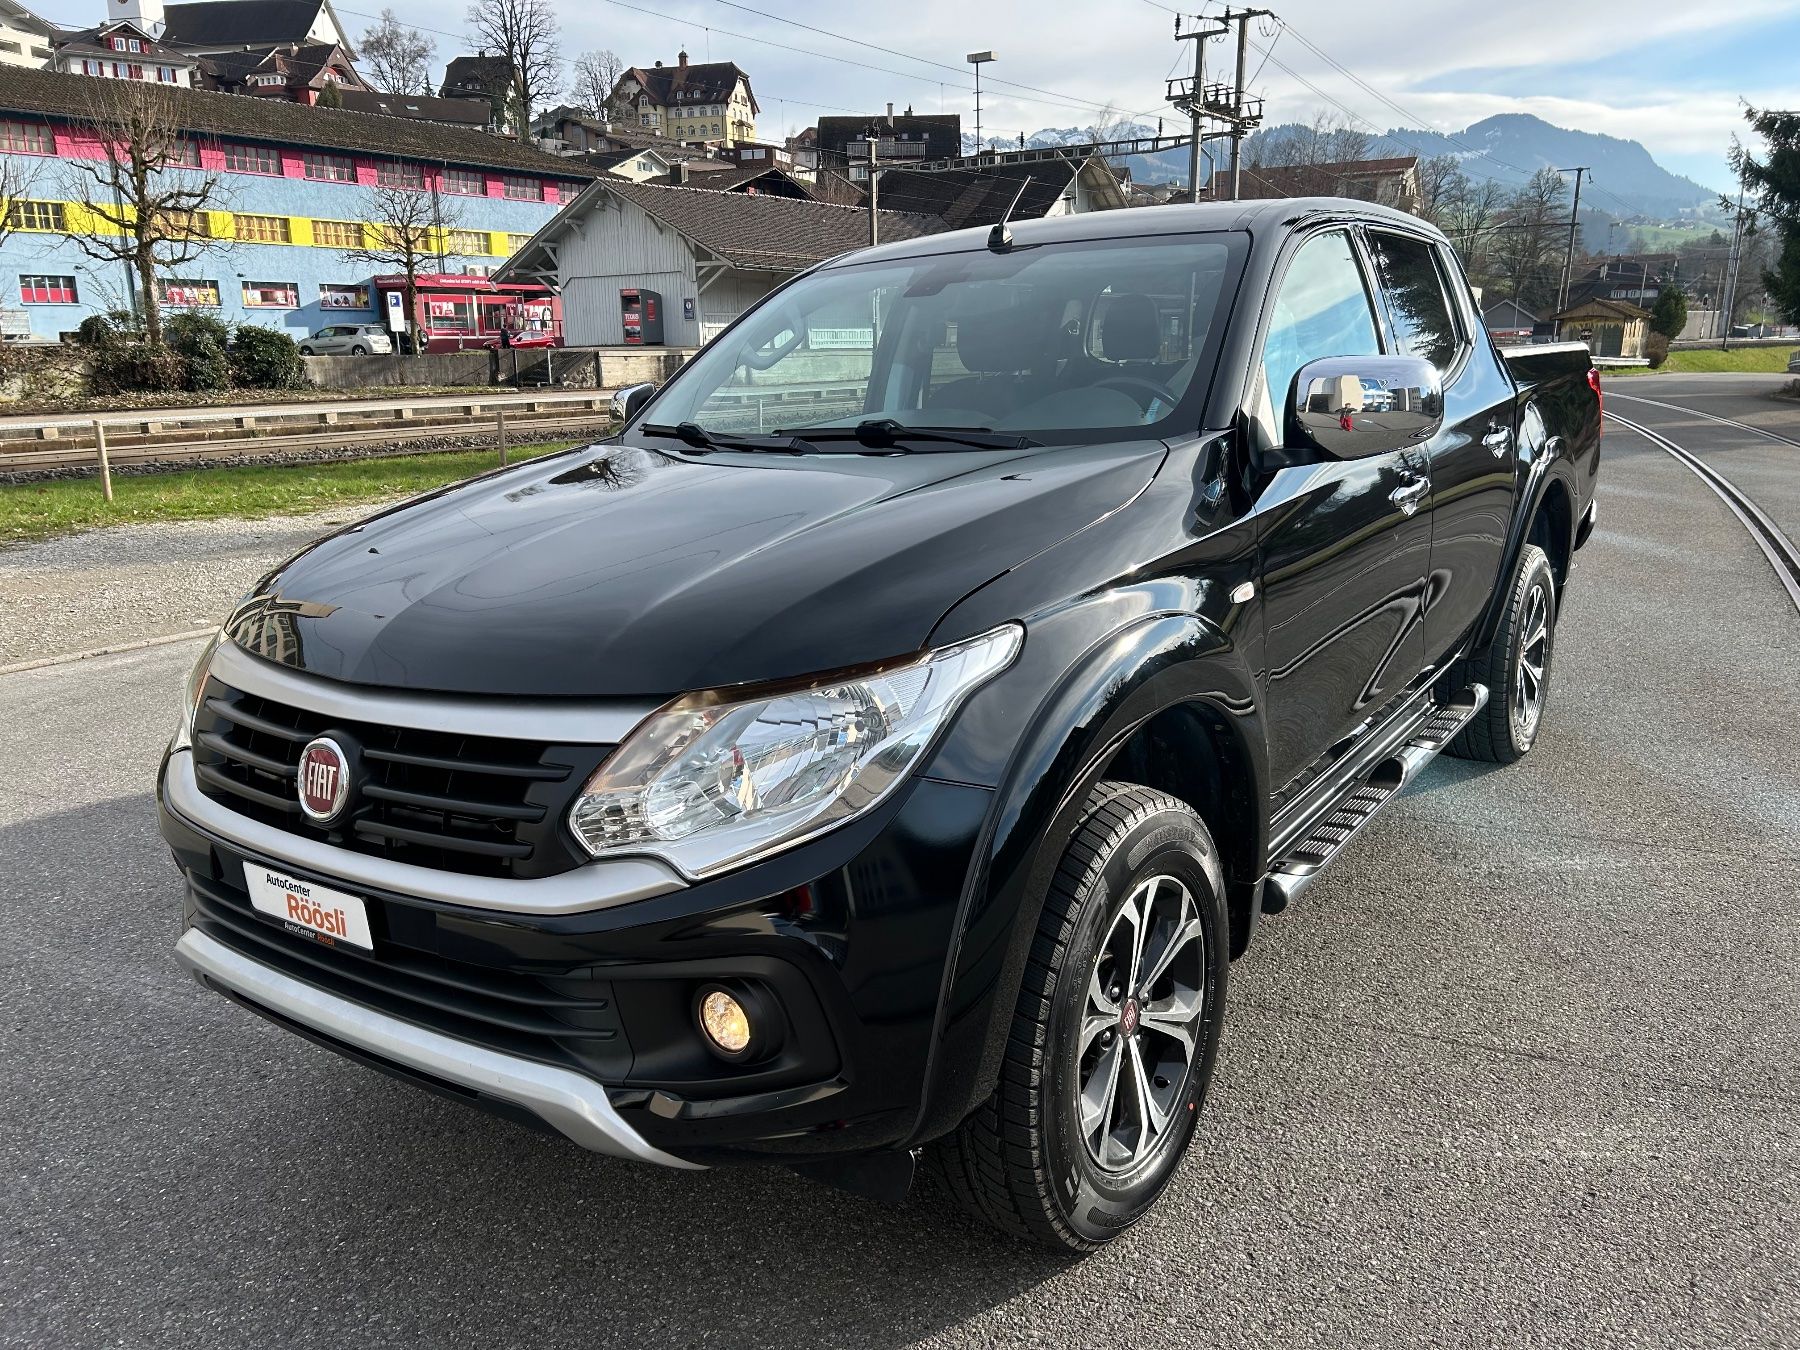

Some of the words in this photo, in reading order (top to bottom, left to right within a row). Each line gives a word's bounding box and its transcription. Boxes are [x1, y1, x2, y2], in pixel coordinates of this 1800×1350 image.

[306, 761, 337, 801] FIAT
[266, 873, 311, 898] AutoCenter
[284, 921, 316, 939] AutoCenter
[286, 893, 348, 938] Röösli
